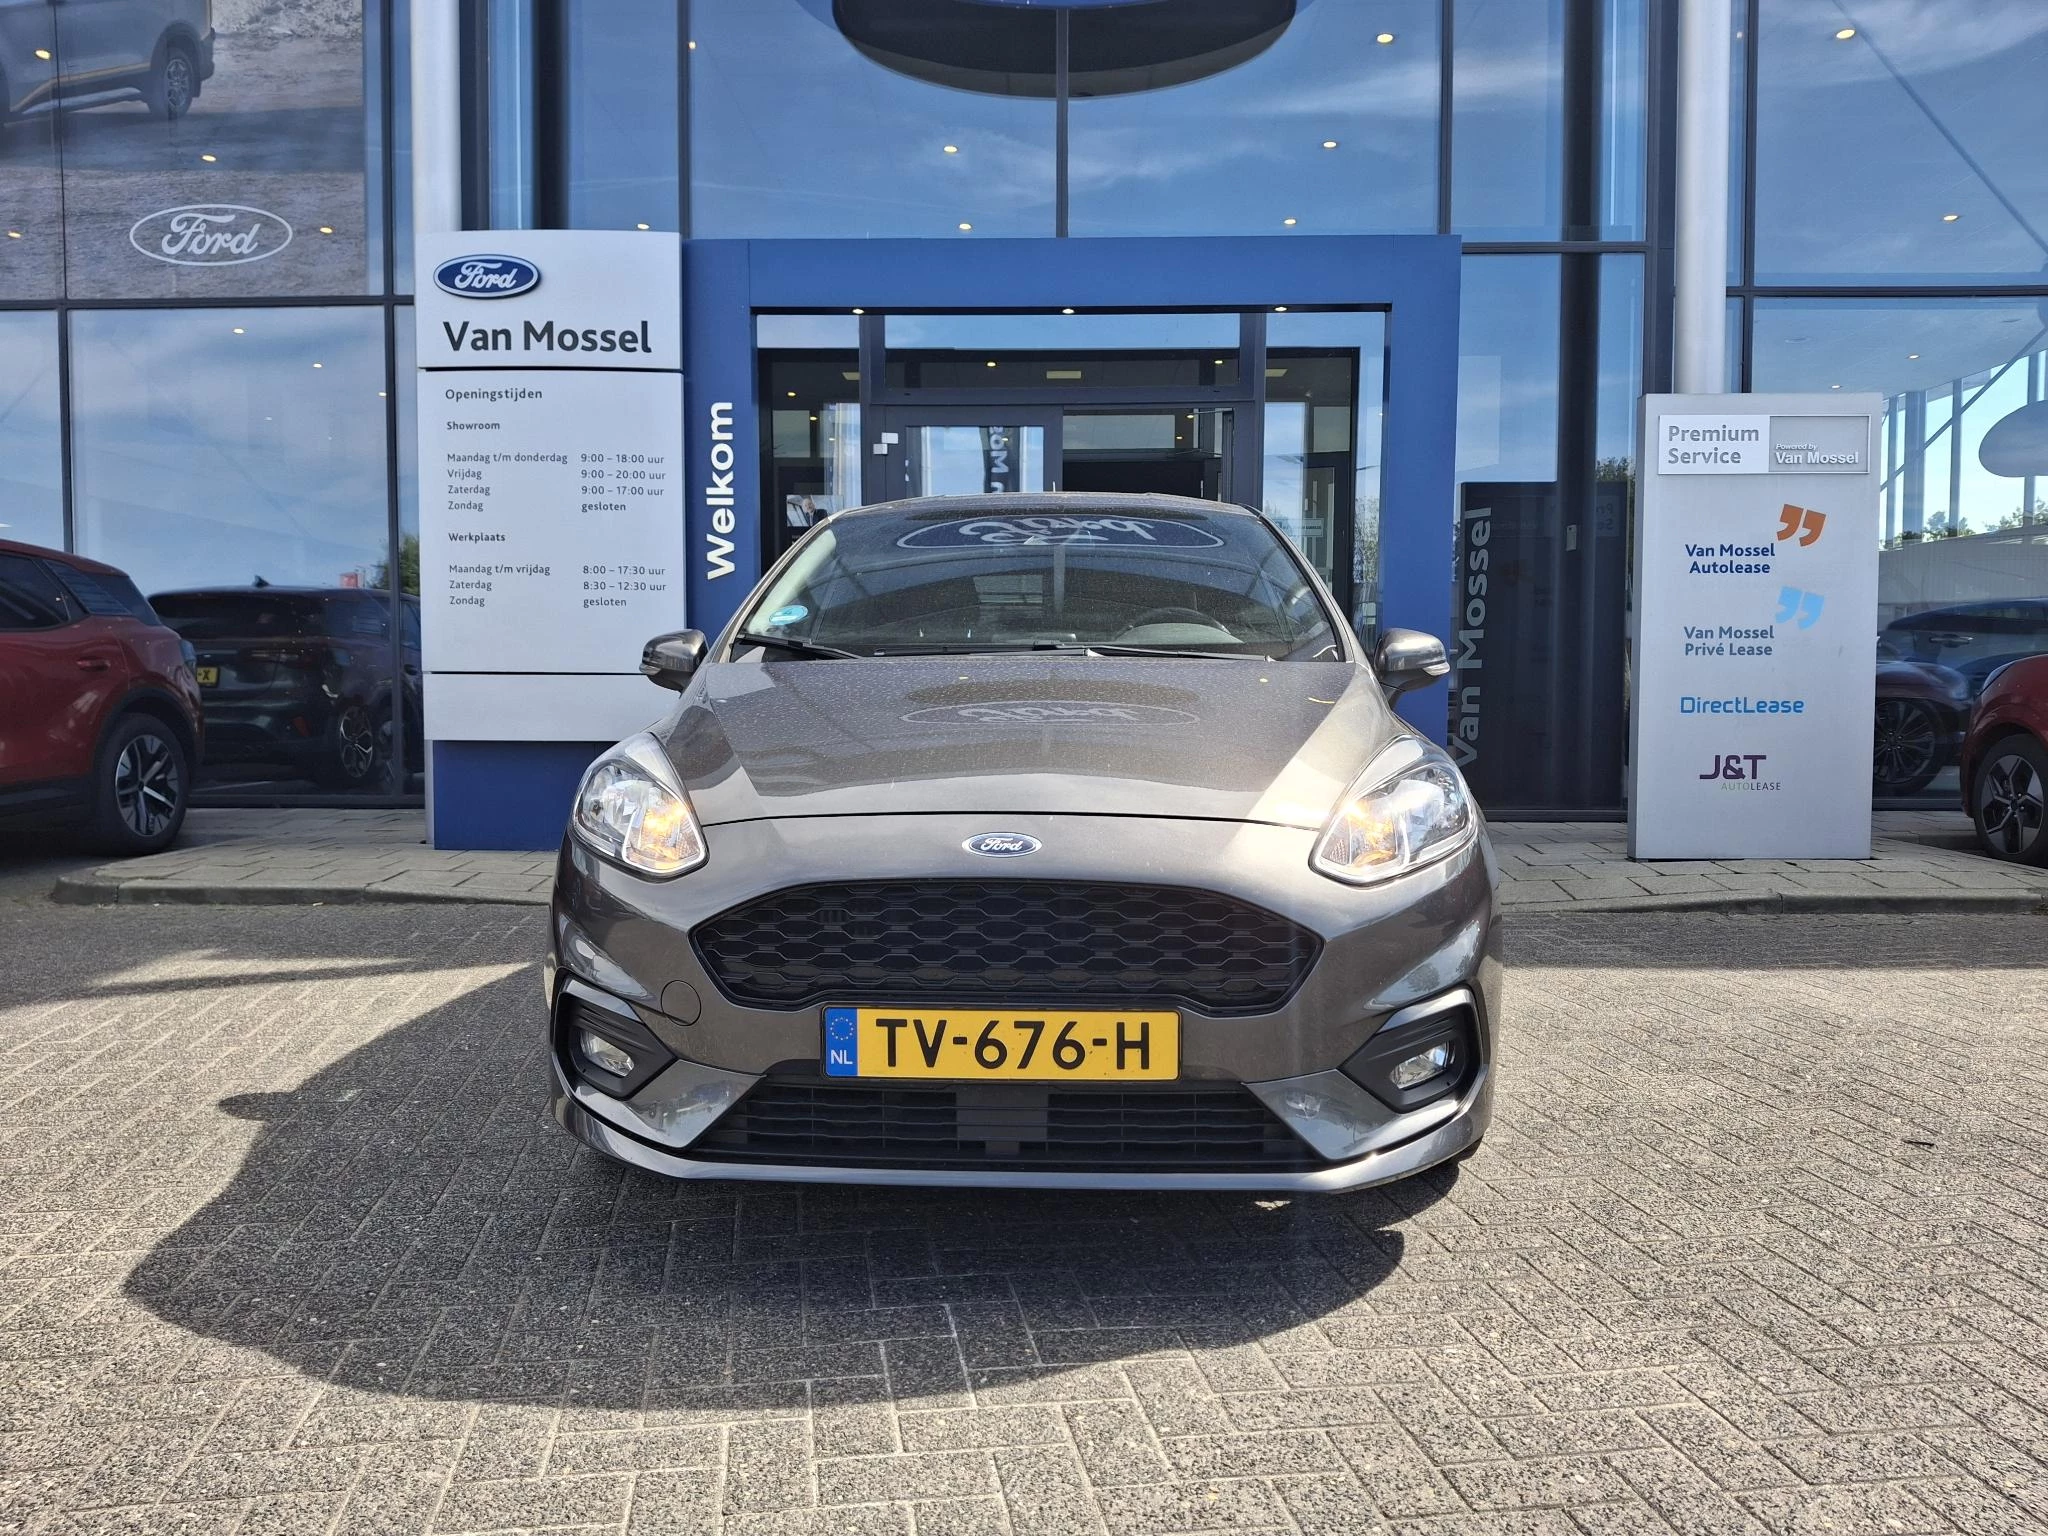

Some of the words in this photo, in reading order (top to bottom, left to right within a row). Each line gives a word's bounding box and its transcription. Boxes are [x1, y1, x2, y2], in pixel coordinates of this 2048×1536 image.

[161, 213, 261, 255] Ford
[454, 261, 518, 289] Ford
[442, 321, 512, 351] Van
[523, 320, 652, 353] Mossel
[445, 388, 542, 402] Openingstijden
[447, 421, 500, 430] Showroom
[1668, 425, 1759, 442] Premium
[447, 454, 490, 464] Maandag
[493, 454, 511, 462] t/m
[514, 454, 568, 464] donderdag
[581, 454, 604, 463] 9:00
[616, 454, 644, 463] 18:00
[648, 456, 664, 464] uur
[1668, 448, 1741, 464] Service
[1776, 452, 1802, 464] Van
[1808, 452, 1858, 464] Mossel
[447, 470, 482, 480] Vrijdag
[581, 470, 604, 479] 9:00
[616, 470, 645, 479] 20:00
[649, 472, 666, 480] uur
[448, 485, 490, 496] Zaterdag
[581, 486, 604, 495] 9:00
[616, 487, 644, 495] 17:00
[648, 488, 664, 496] uur
[706, 402, 736, 580] Welkom
[448, 502, 483, 512] Zondag
[581, 502, 626, 513] gesloten
[449, 533, 505, 544] Werkplaats
[1685, 544, 1714, 557] Van
[1720, 543, 1775, 557] Mossel
[449, 565, 492, 575] Maandag
[495, 565, 513, 574] t/m
[516, 565, 550, 576] vrijdag
[583, 566, 606, 575] 8:00
[618, 566, 645, 575] 17:30
[1689, 560, 1770, 574] Autolease
[450, 580, 492, 591] Zaterdag
[583, 582, 606, 590] 8:30
[618, 582, 646, 591] 12:30
[1456, 507, 1492, 669] Mossel
[450, 596, 485, 607] Zondag
[584, 598, 626, 608] gesloten
[1684, 626, 1714, 639] Van
[1719, 626, 1774, 639] Mossel
[1685, 642, 1724, 656] Privé
[1729, 643, 1772, 656] Lease
[1680, 697, 1804, 714] DirectLease
[1450, 686, 1481, 768] Van
[1700, 755, 1766, 780] J&T
[1721, 782, 1781, 791] AUTOLEASE
[980, 836, 1024, 851] Ford
[876, 1018, 1150, 1070] TV-676-H
[830, 1050, 853, 1066] NL
